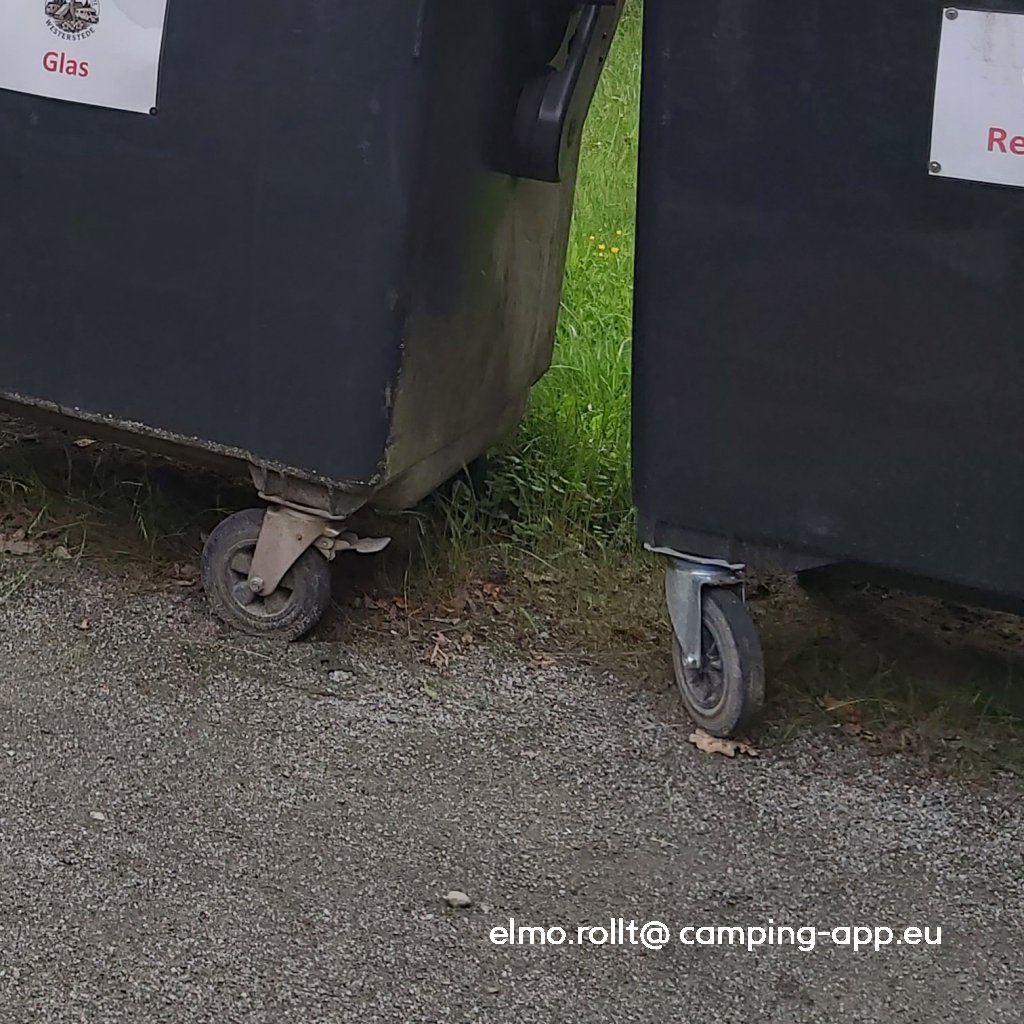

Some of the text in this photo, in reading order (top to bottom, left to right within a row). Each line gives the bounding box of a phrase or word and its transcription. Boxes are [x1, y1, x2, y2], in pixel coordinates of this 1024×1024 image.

[45, 19, 96, 41] WESTERSTEDE
[42, 51, 90, 78] Glas
[987, 127, 1024, 156] Re
